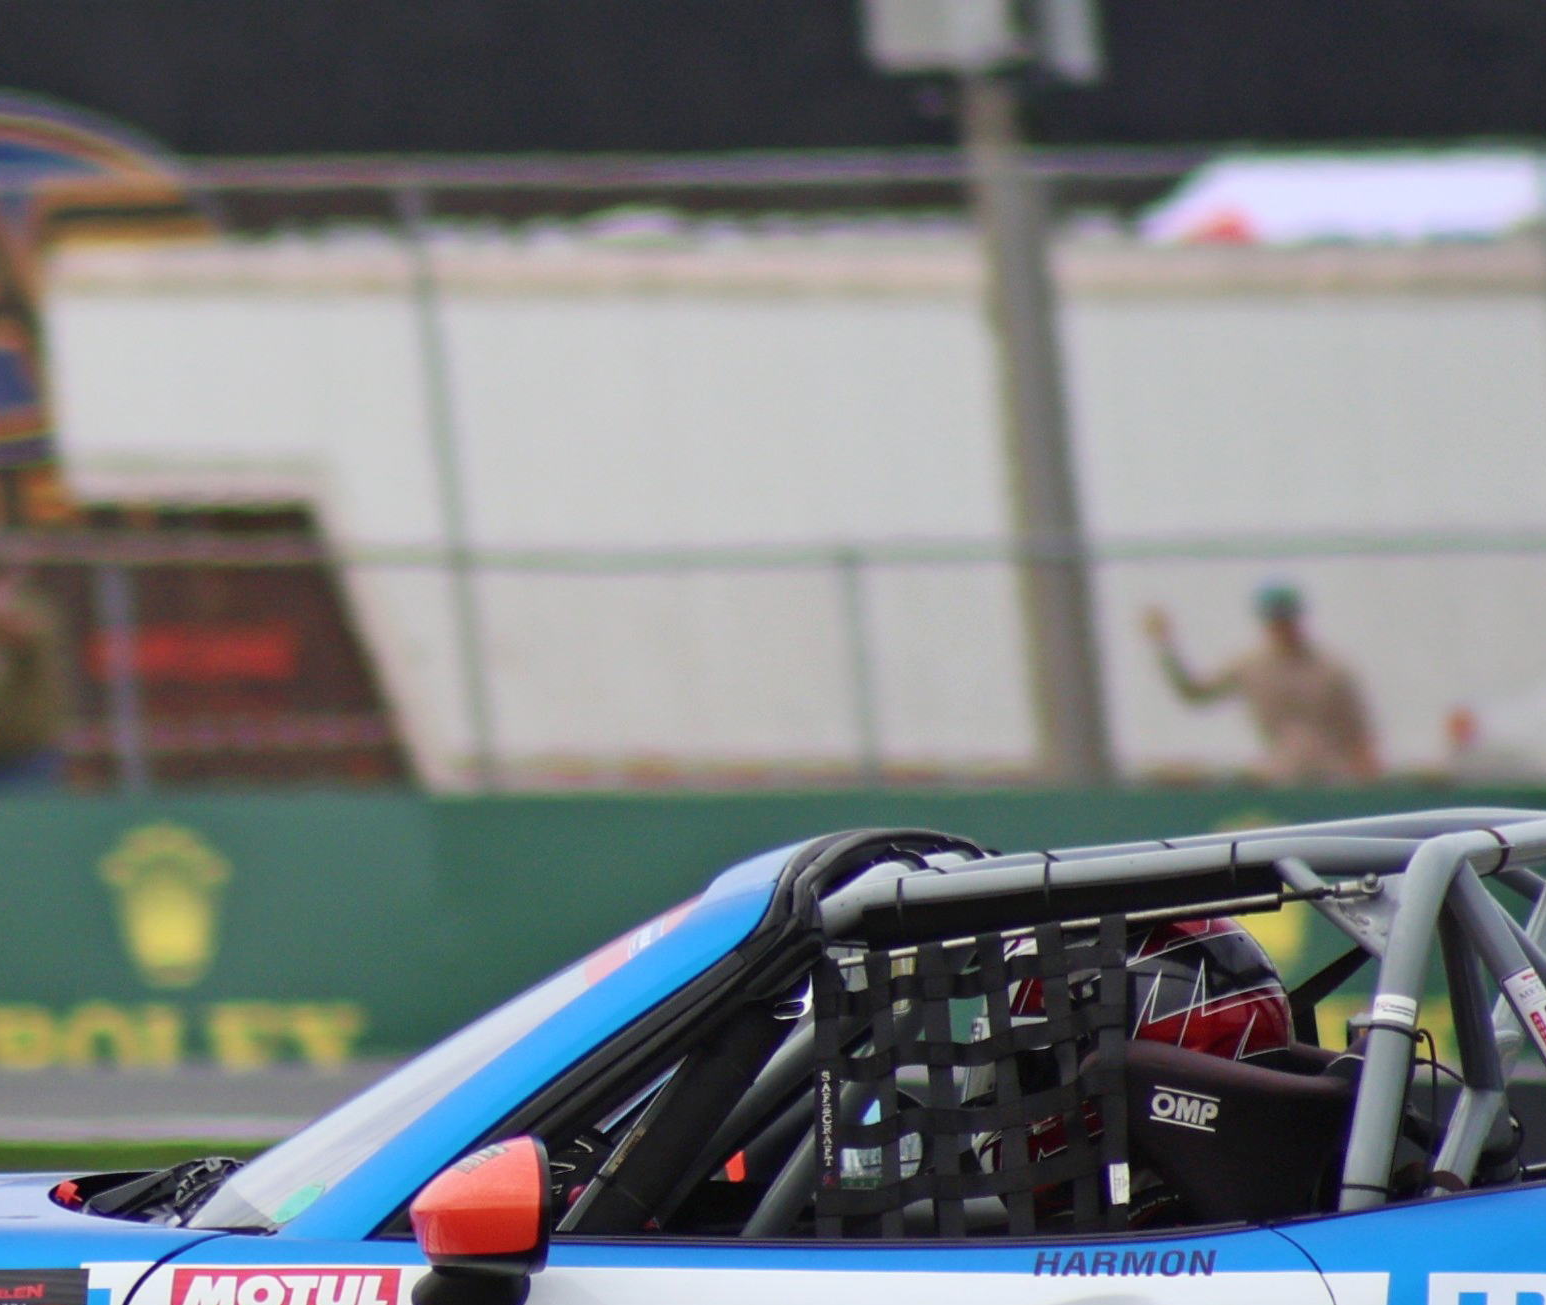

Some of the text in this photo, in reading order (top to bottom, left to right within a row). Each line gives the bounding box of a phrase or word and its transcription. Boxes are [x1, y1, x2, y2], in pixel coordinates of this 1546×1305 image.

[820, 1070, 833, 1167] SAFECRAFT
[1151, 1092, 1219, 1125] OMP
[1033, 1249, 1217, 1278] HARMON
